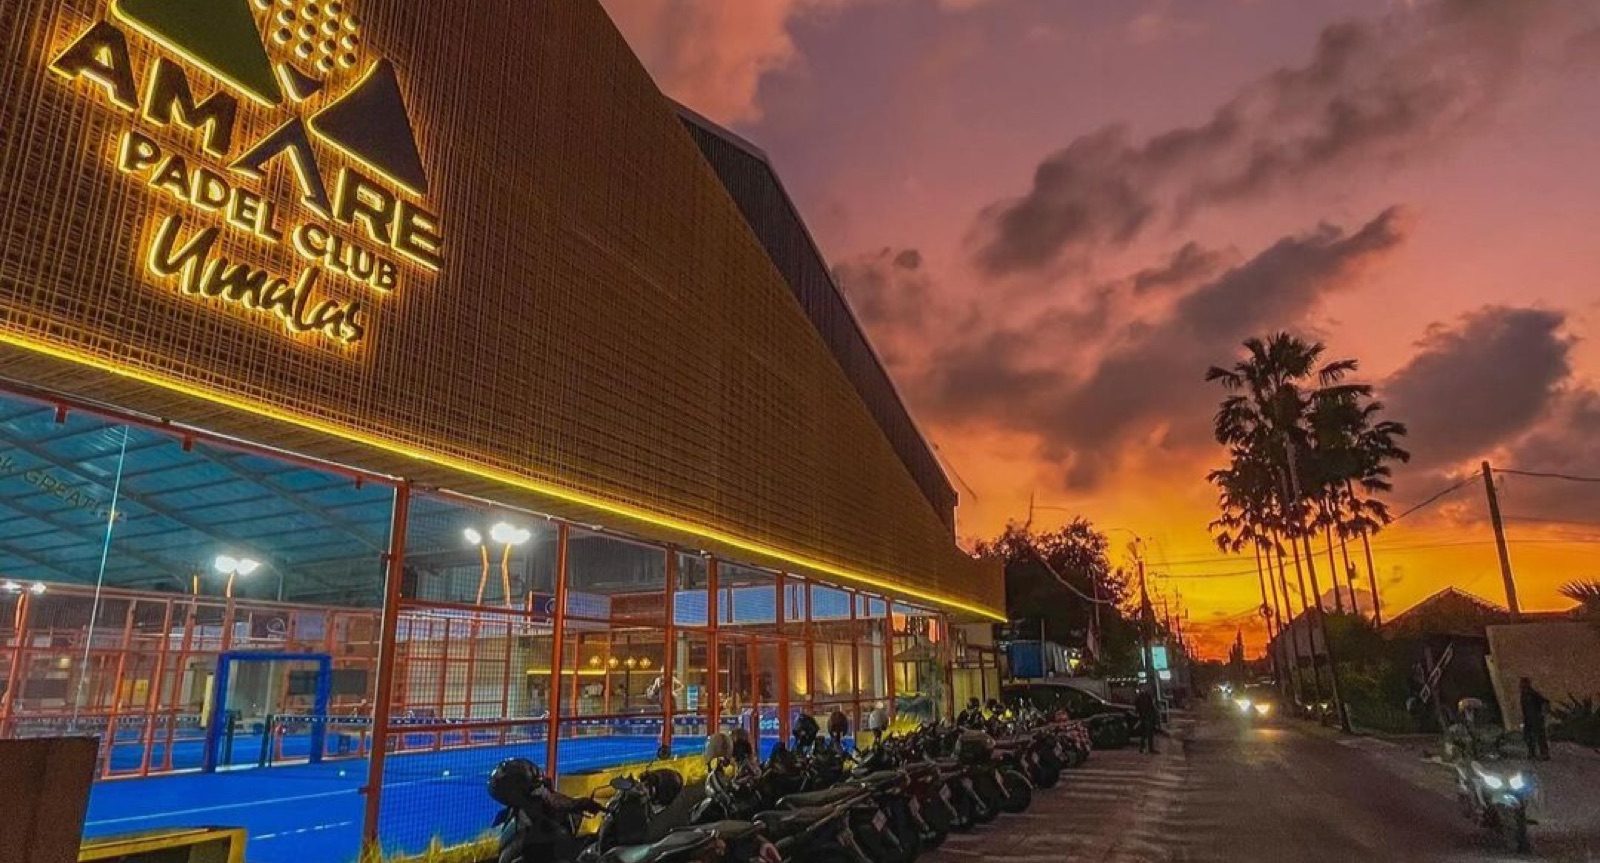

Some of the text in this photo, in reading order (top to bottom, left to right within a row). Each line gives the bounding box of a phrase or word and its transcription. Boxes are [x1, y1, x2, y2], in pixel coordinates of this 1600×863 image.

[49, 20, 444, 271] AMARE
[118, 131, 398, 292] PADEL CLUB
[149, 214, 364, 343] Umalas
